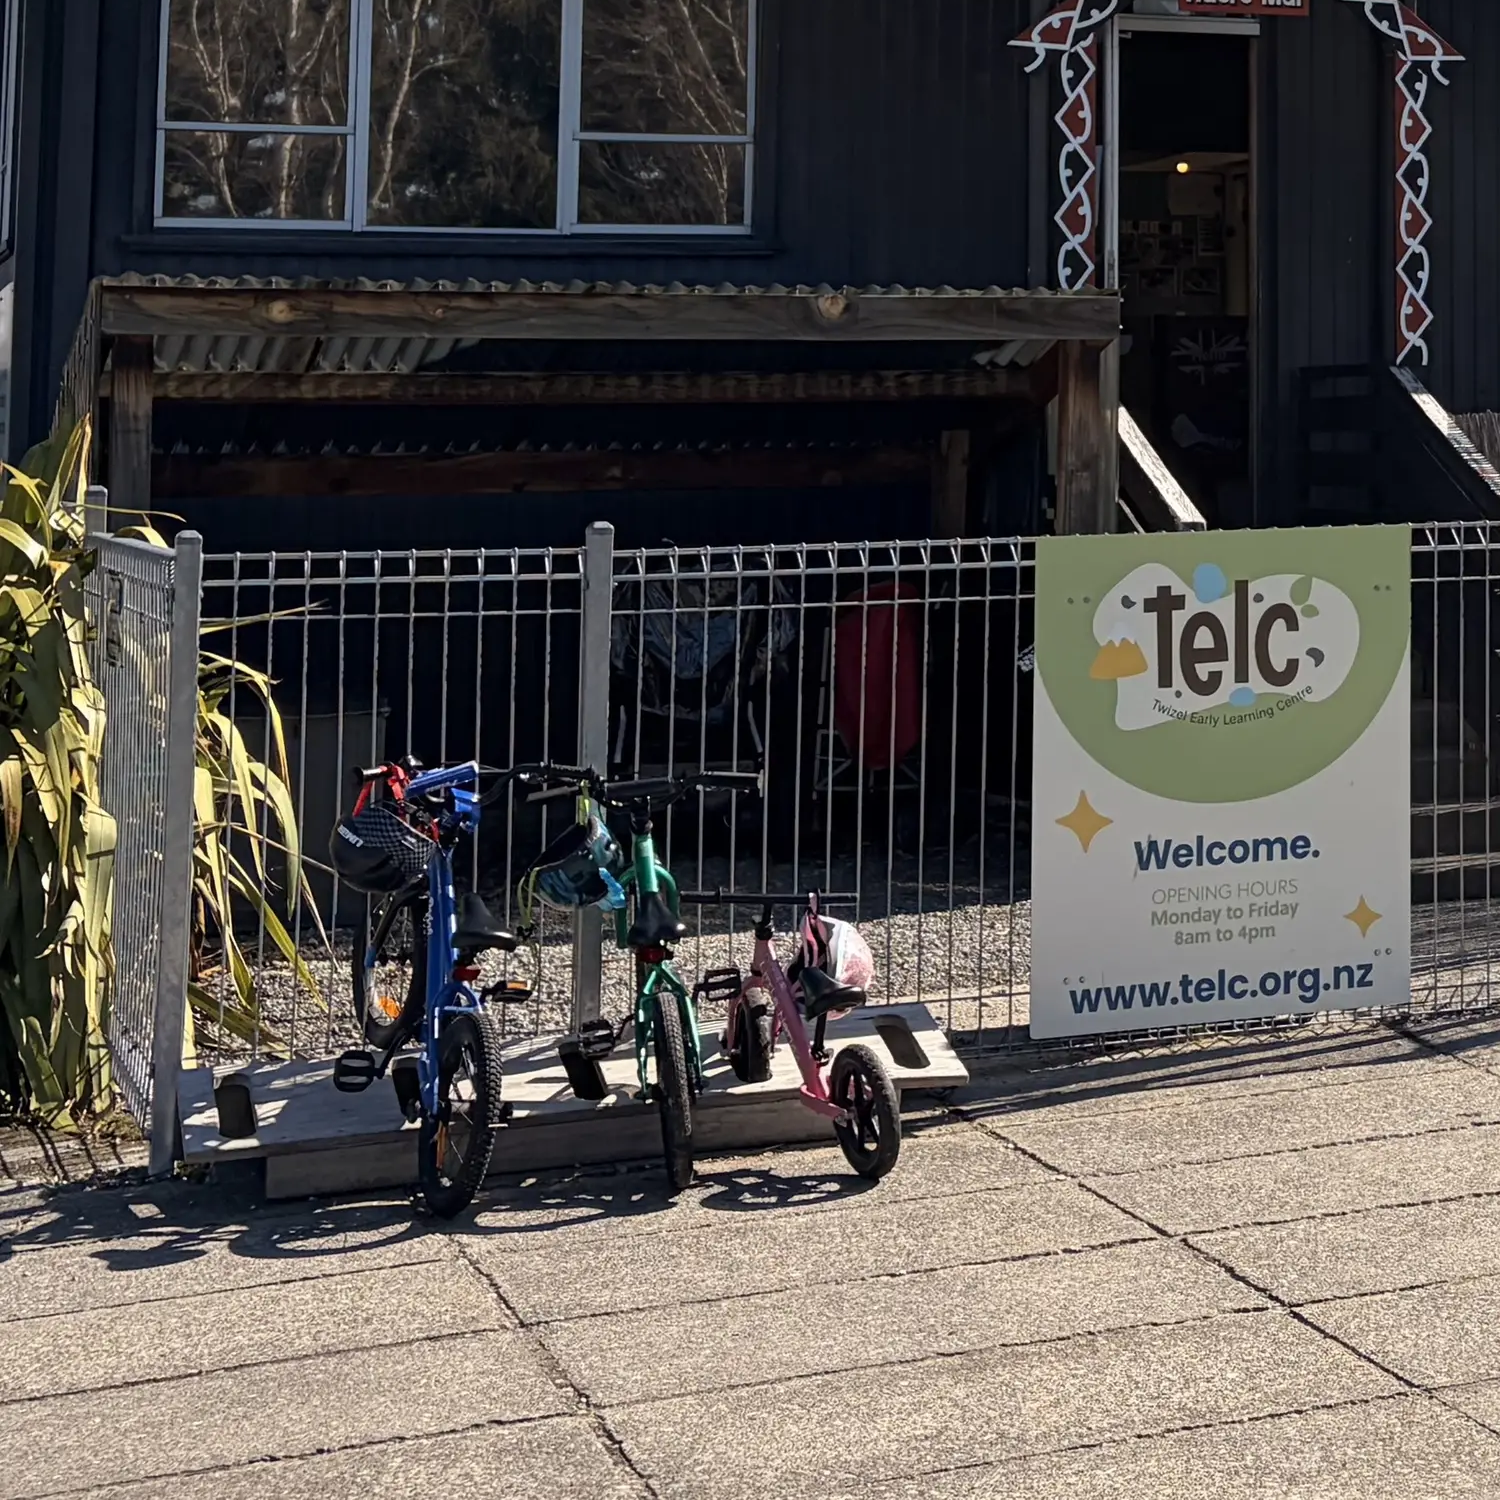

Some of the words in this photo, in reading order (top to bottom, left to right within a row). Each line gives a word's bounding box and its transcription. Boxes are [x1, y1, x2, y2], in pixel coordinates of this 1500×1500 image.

[1143, 579, 1300, 696] telc
[1152, 699, 1188, 721] Twizel
[1189, 712, 1220, 728] Early
[1223, 709, 1275, 726] Learning
[1276, 685, 1313, 712] Centre
[1134, 835, 1321, 871] Welcome.
[1152, 884, 1232, 905] OPENING
[1237, 878, 1299, 898] HOURS
[1151, 906, 1222, 926] Monday
[1226, 906, 1244, 920] to
[1248, 900, 1299, 919] Friday
[1174, 930, 1211, 945] 8am
[1216, 927, 1234, 942] to
[1238, 925, 1276, 944] 4pm
[1069, 963, 1374, 1015] www.telc.org.nz
